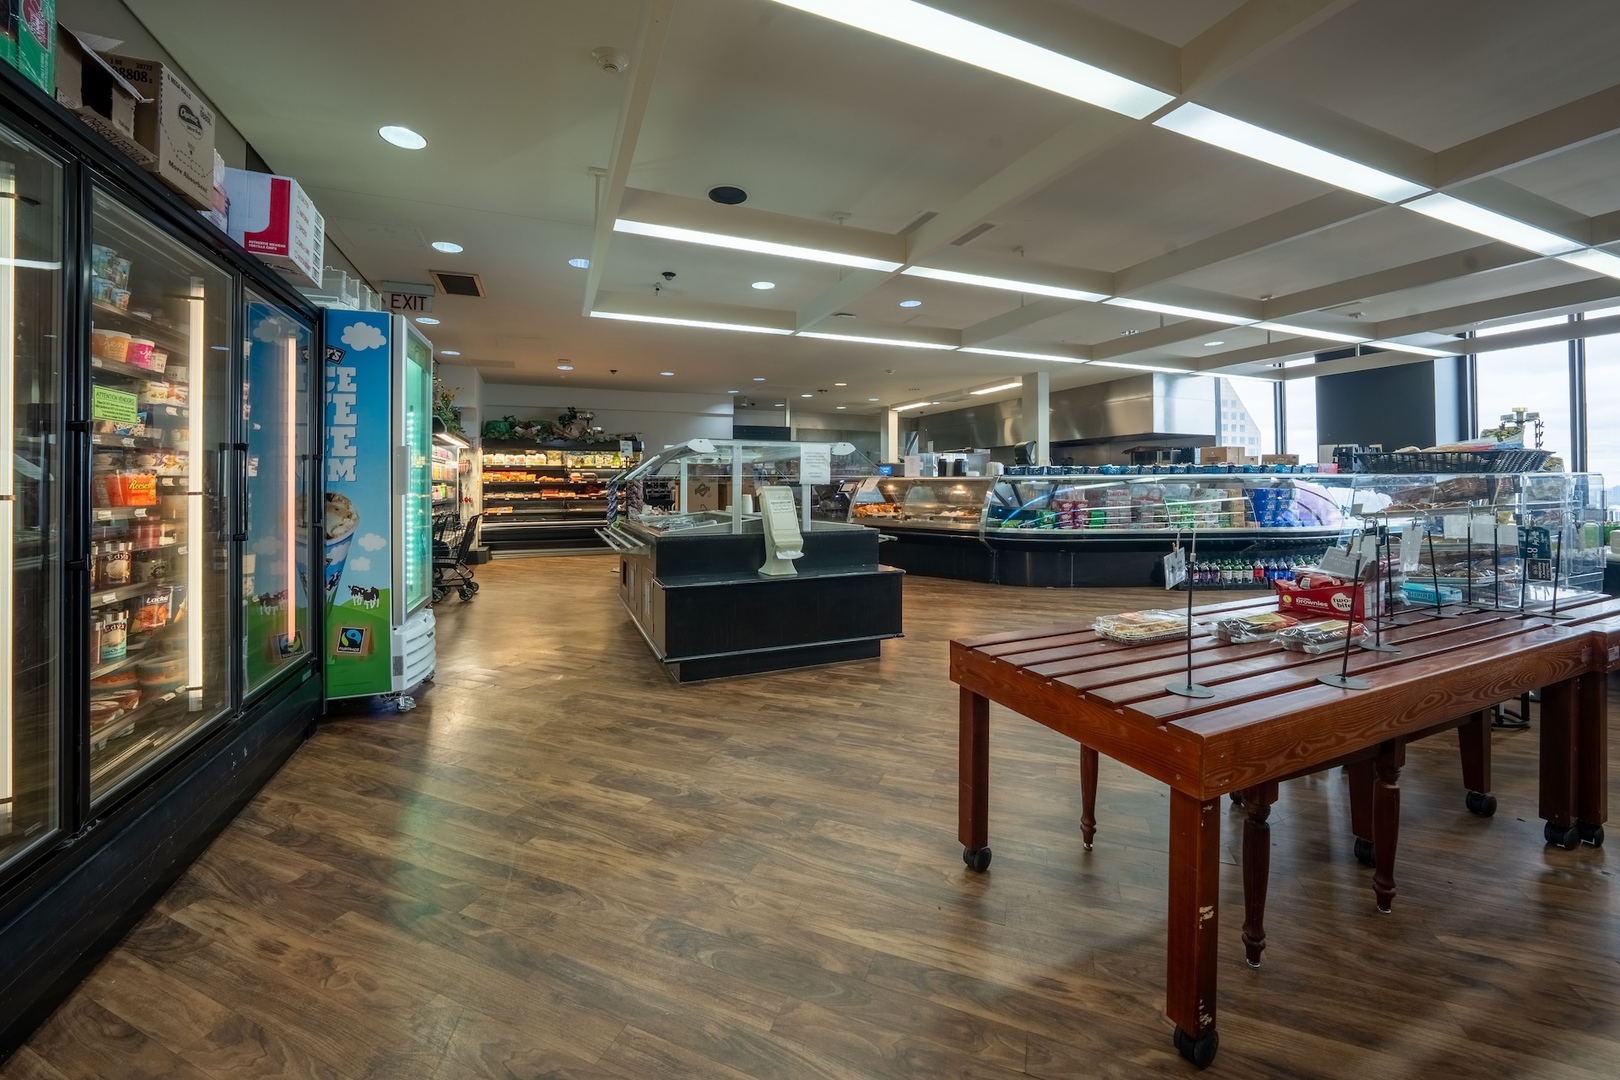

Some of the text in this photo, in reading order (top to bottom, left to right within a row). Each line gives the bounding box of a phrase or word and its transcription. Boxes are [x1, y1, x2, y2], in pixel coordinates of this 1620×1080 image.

[168, 159, 208, 194] More Absorbent
[391, 294, 427, 311] EXIT
[96, 391, 118, 400] ATTENTION
[1296, 597, 1329, 607] brownies
